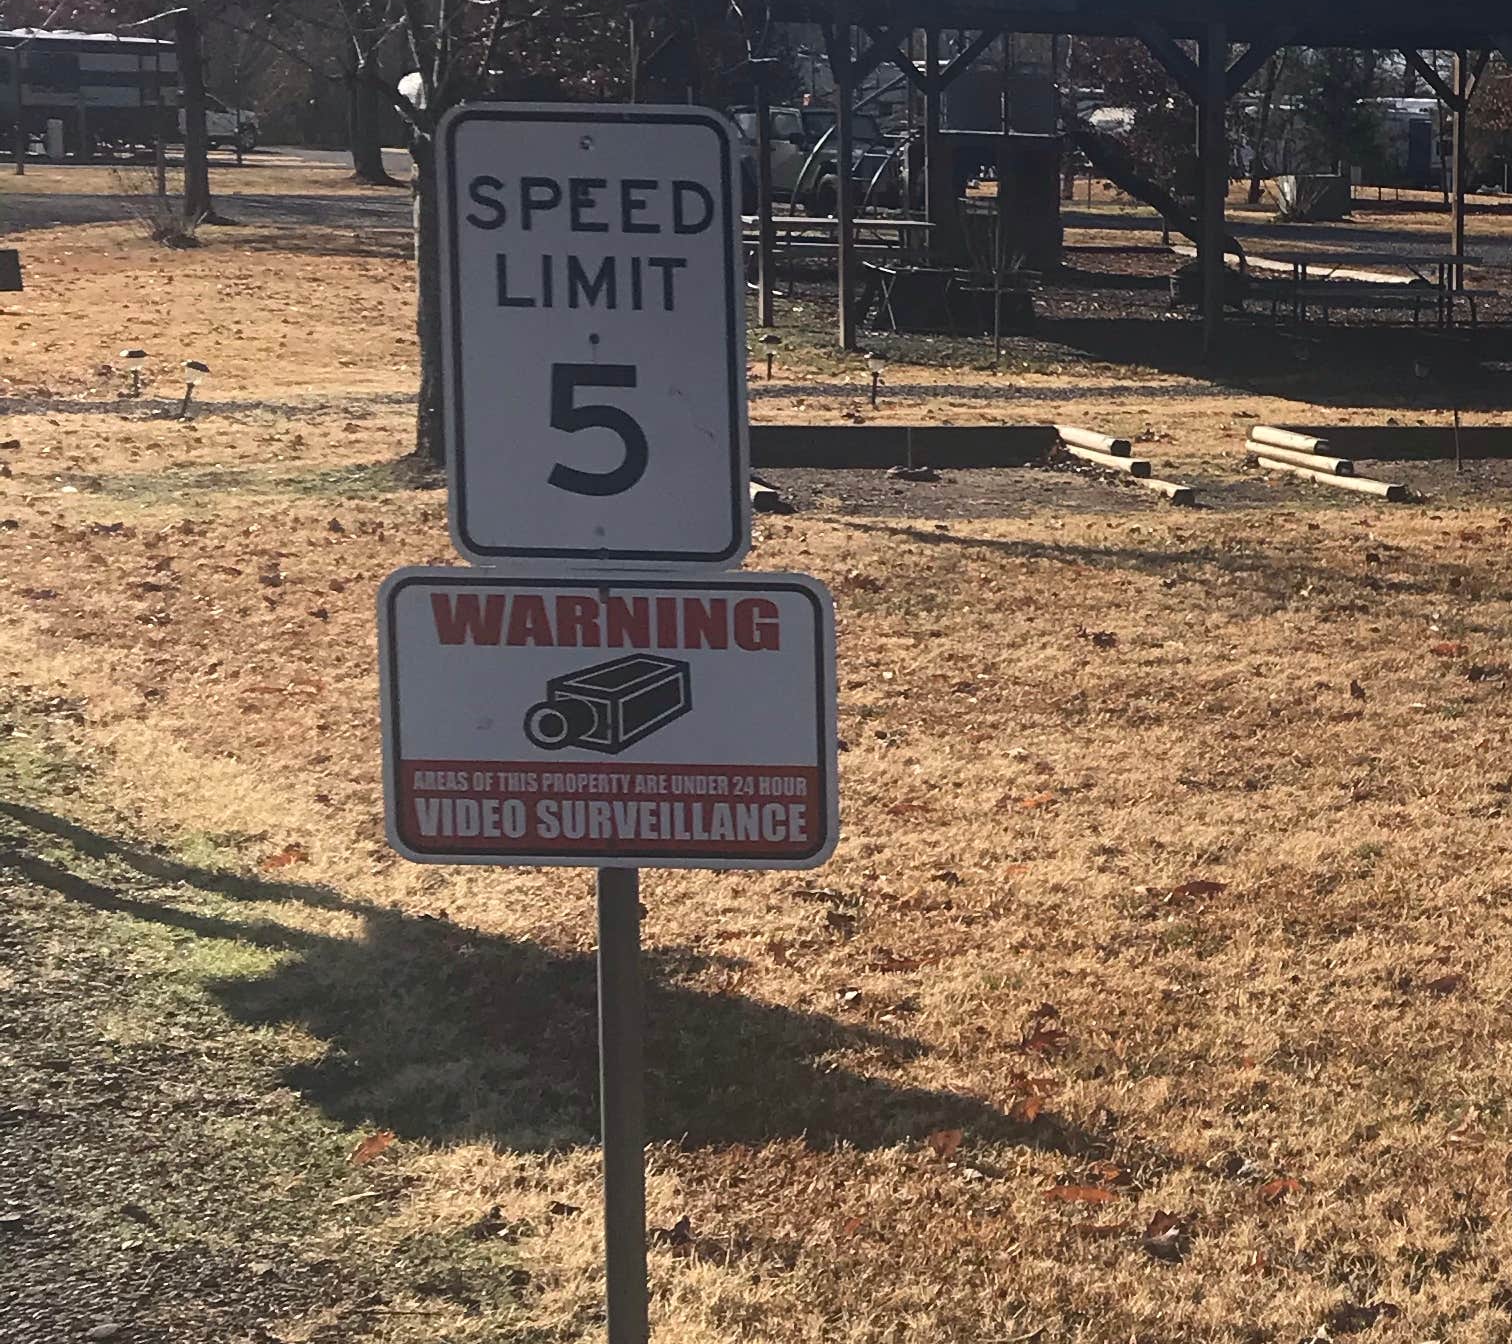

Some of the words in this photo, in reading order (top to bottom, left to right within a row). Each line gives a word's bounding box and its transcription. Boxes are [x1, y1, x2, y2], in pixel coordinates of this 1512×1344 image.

[465, 174, 715, 235] SPEED
[495, 252, 687, 312] LIMIT
[547, 362, 649, 497] 5
[430, 592, 780, 652] WARNING
[413, 770, 469, 791] AREAS
[472, 771, 494, 792] OF
[495, 771, 539, 793] THIS
[542, 772, 632, 794] PROPERTY
[634, 773, 668, 795] ARE
[671, 774, 729, 796] UNDER
[733, 775, 755, 796] 24
[759, 776, 808, 797] HOUR
[413, 797, 527, 839] VIDEO
[536, 798, 809, 842] SURVEILLANCE
